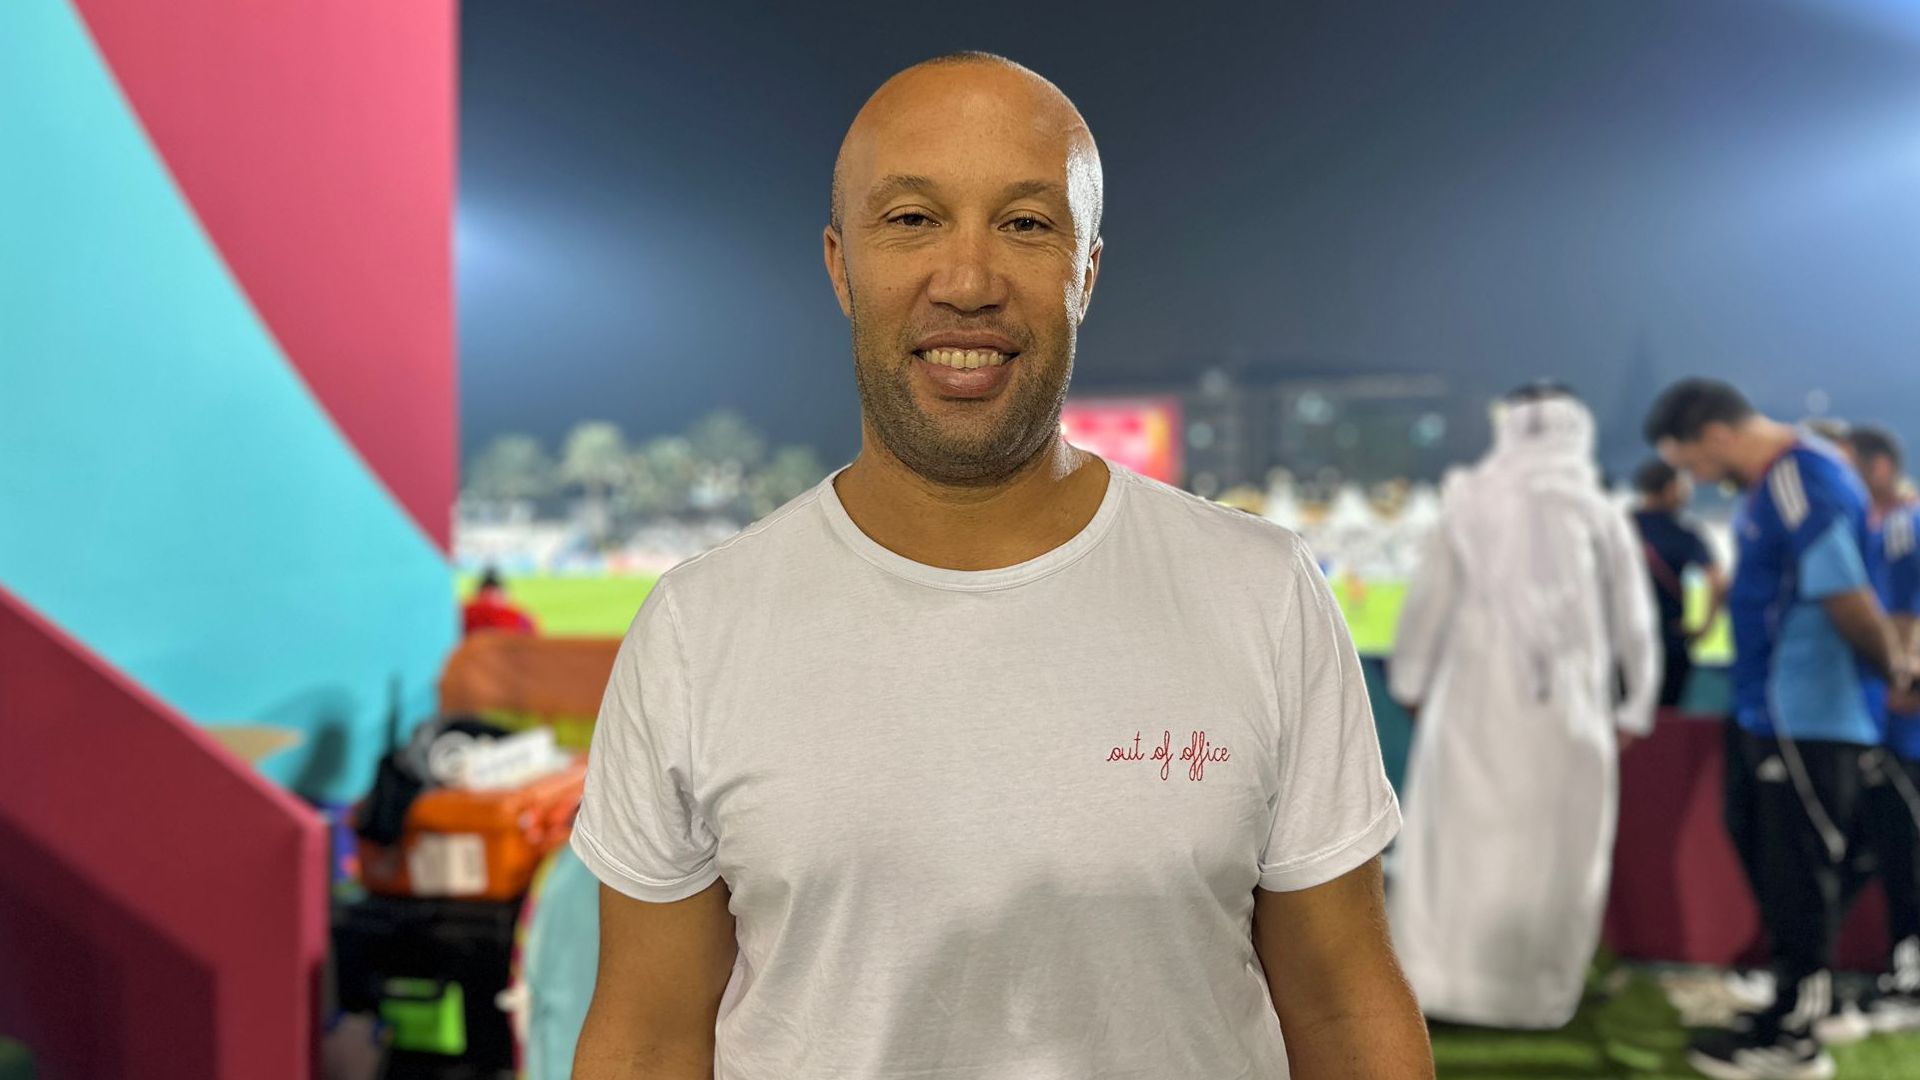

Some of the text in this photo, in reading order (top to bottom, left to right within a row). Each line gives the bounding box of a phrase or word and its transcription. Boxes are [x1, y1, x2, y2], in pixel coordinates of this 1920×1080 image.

[1106, 730, 1231, 781] out of office
